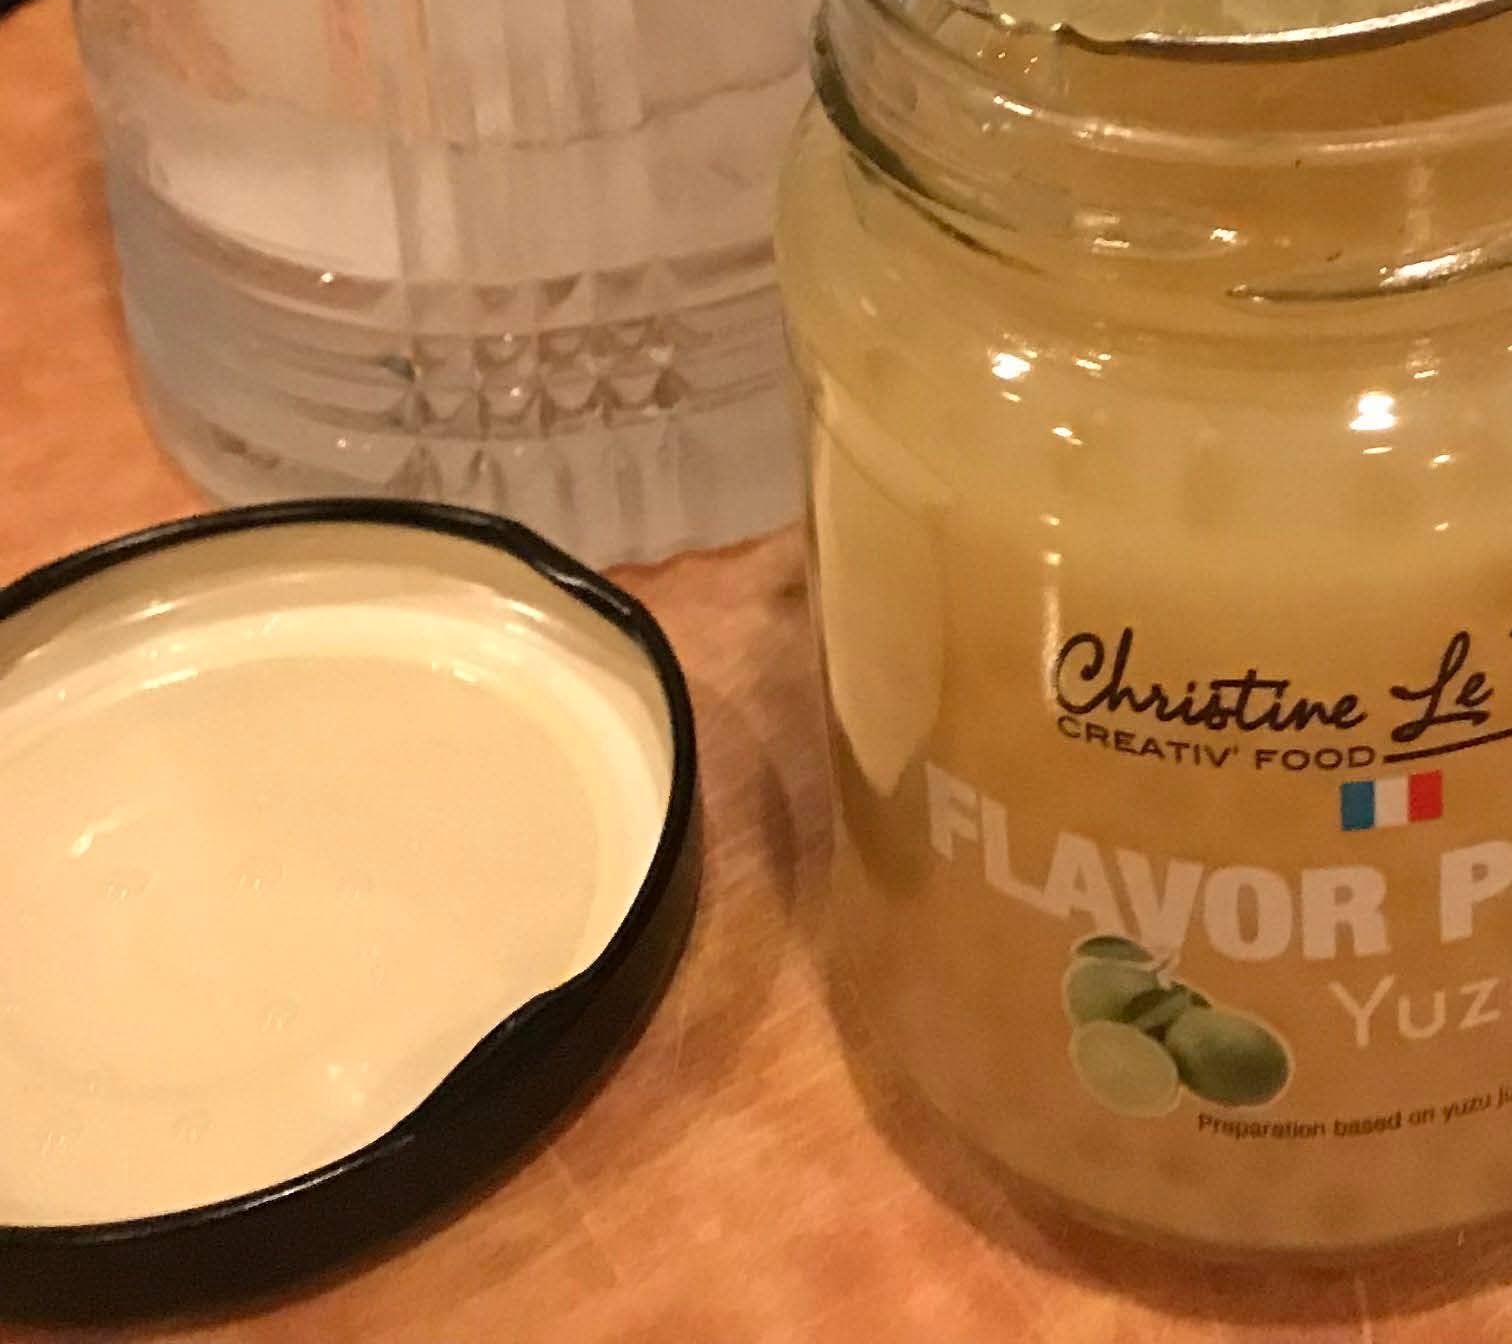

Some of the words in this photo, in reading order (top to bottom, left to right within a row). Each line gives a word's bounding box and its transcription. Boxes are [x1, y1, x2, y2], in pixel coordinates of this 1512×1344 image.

[1055, 627, 1368, 733] Christine
[1391, 630, 1494, 743] Le
[1255, 745, 1377, 771] FOOD
[926, 760, 1392, 962] FLAVOR
[1198, 1113, 1327, 1140] Preparation
[1333, 1111, 1403, 1139] based
[1407, 1107, 1436, 1128] on
[1442, 1093, 1493, 1124] yuzu
